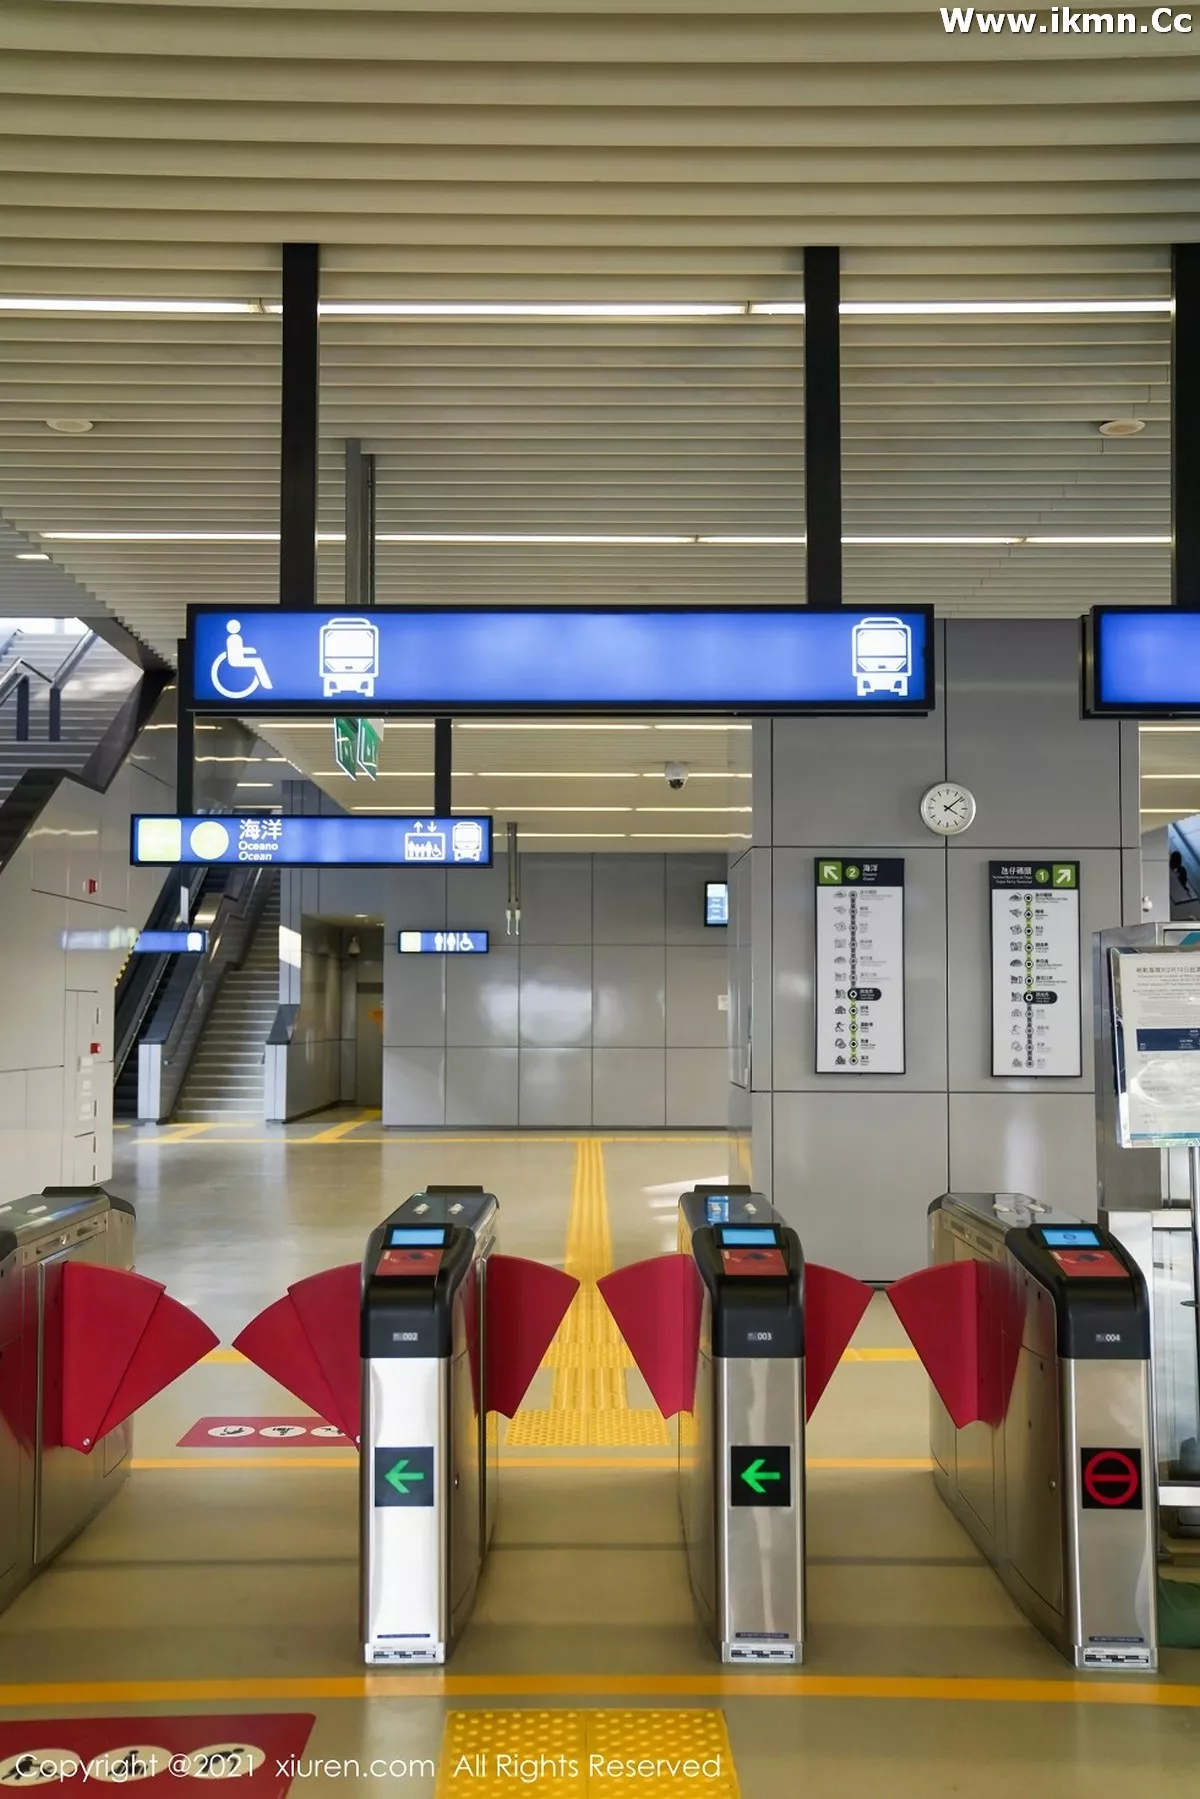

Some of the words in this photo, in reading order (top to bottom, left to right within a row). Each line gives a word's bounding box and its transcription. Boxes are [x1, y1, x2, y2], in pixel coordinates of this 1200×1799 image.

[239, 819, 283, 840] 海洋
[238, 840, 279, 850] Oceano
[238, 851, 272, 860] Ocean
[849, 868, 856, 877] 2
[1039, 872, 1044, 880] 1
[402, 1332, 418, 1341] 002
[757, 1332, 772, 1341] 003
[1105, 1333, 1120, 1342] 004
